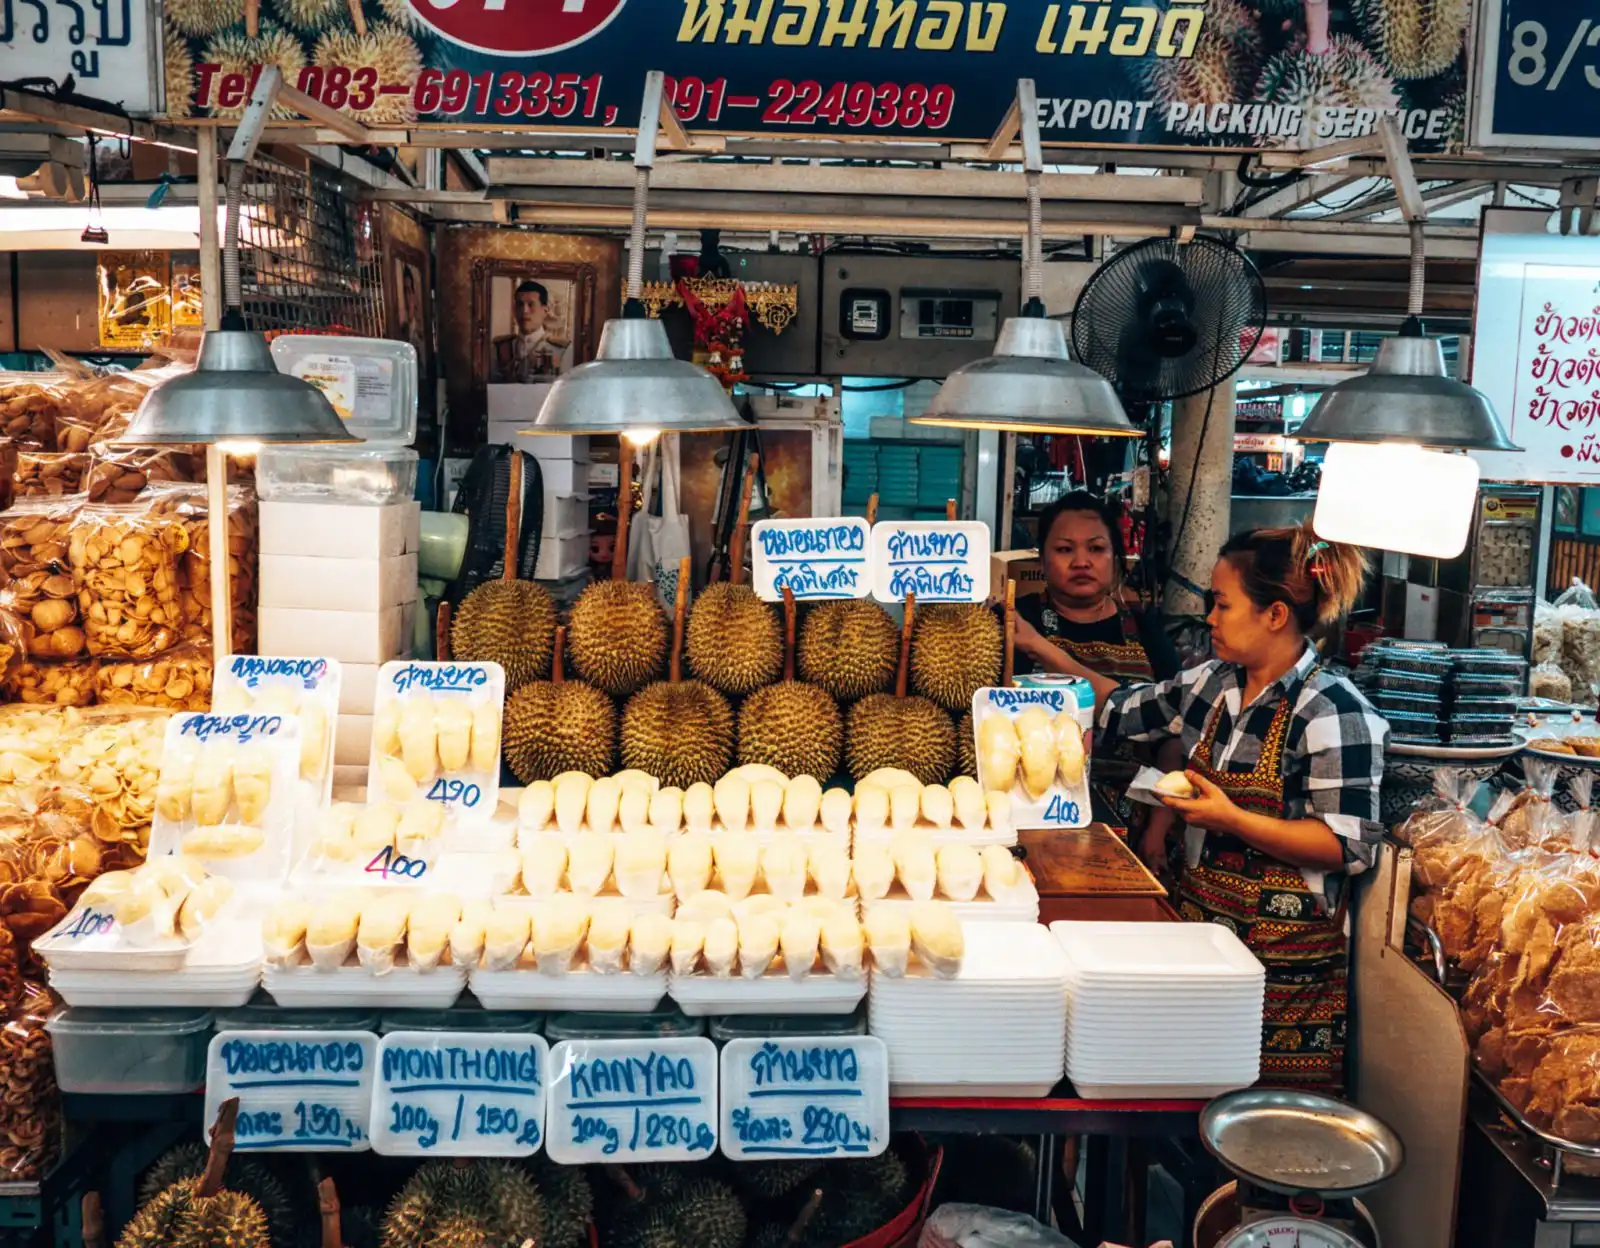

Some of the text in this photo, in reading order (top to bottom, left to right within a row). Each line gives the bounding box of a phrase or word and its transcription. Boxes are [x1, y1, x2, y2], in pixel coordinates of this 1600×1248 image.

[1037, 98, 1153, 130] EXPORT
[1165, 102, 1302, 136] PACKING
[1042, 794, 1081, 825] 400
[364, 845, 427, 880] 400
[381, 1044, 539, 1083] MONTHONG
[570, 1051, 695, 1098] KANYAO
[389, 1101, 440, 1149] 100g
[571, 1113, 619, 1155] 100g
